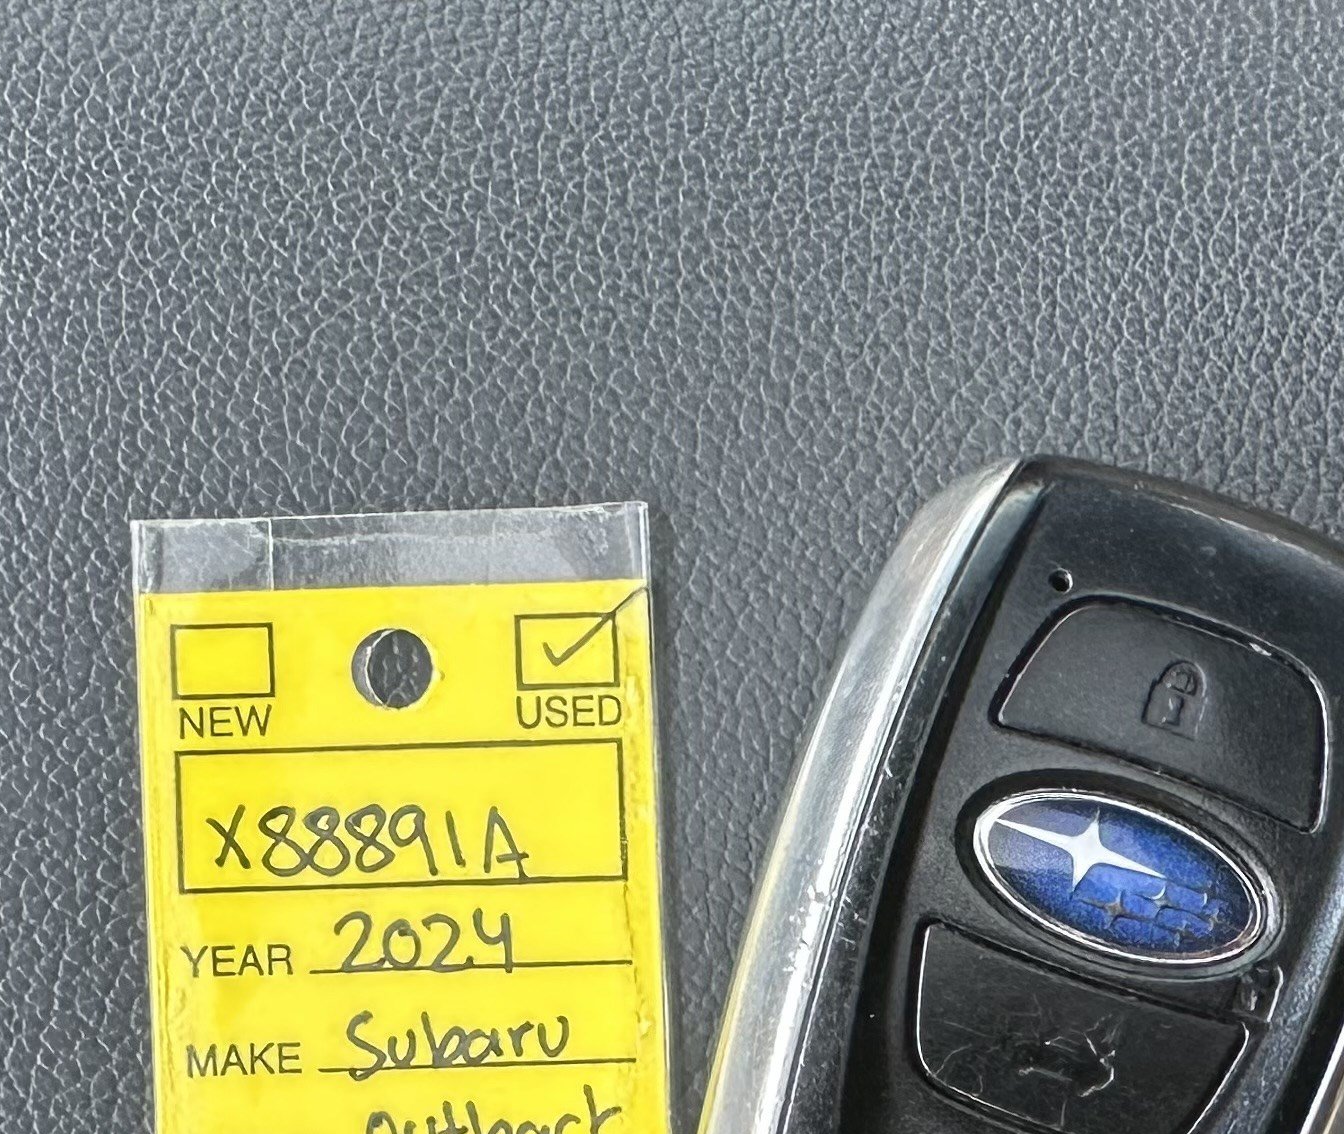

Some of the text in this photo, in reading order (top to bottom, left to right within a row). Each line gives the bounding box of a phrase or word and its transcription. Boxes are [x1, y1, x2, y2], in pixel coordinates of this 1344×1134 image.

[179, 705, 271, 739] NEW
[516, 694, 622, 729] USED
[206, 803, 530, 878] X88891A
[334, 908, 514, 974] 2024
[181, 944, 293, 977] YEAR
[186, 1042, 303, 1079] MAKE
[346, 1010, 570, 1081] Subaru
